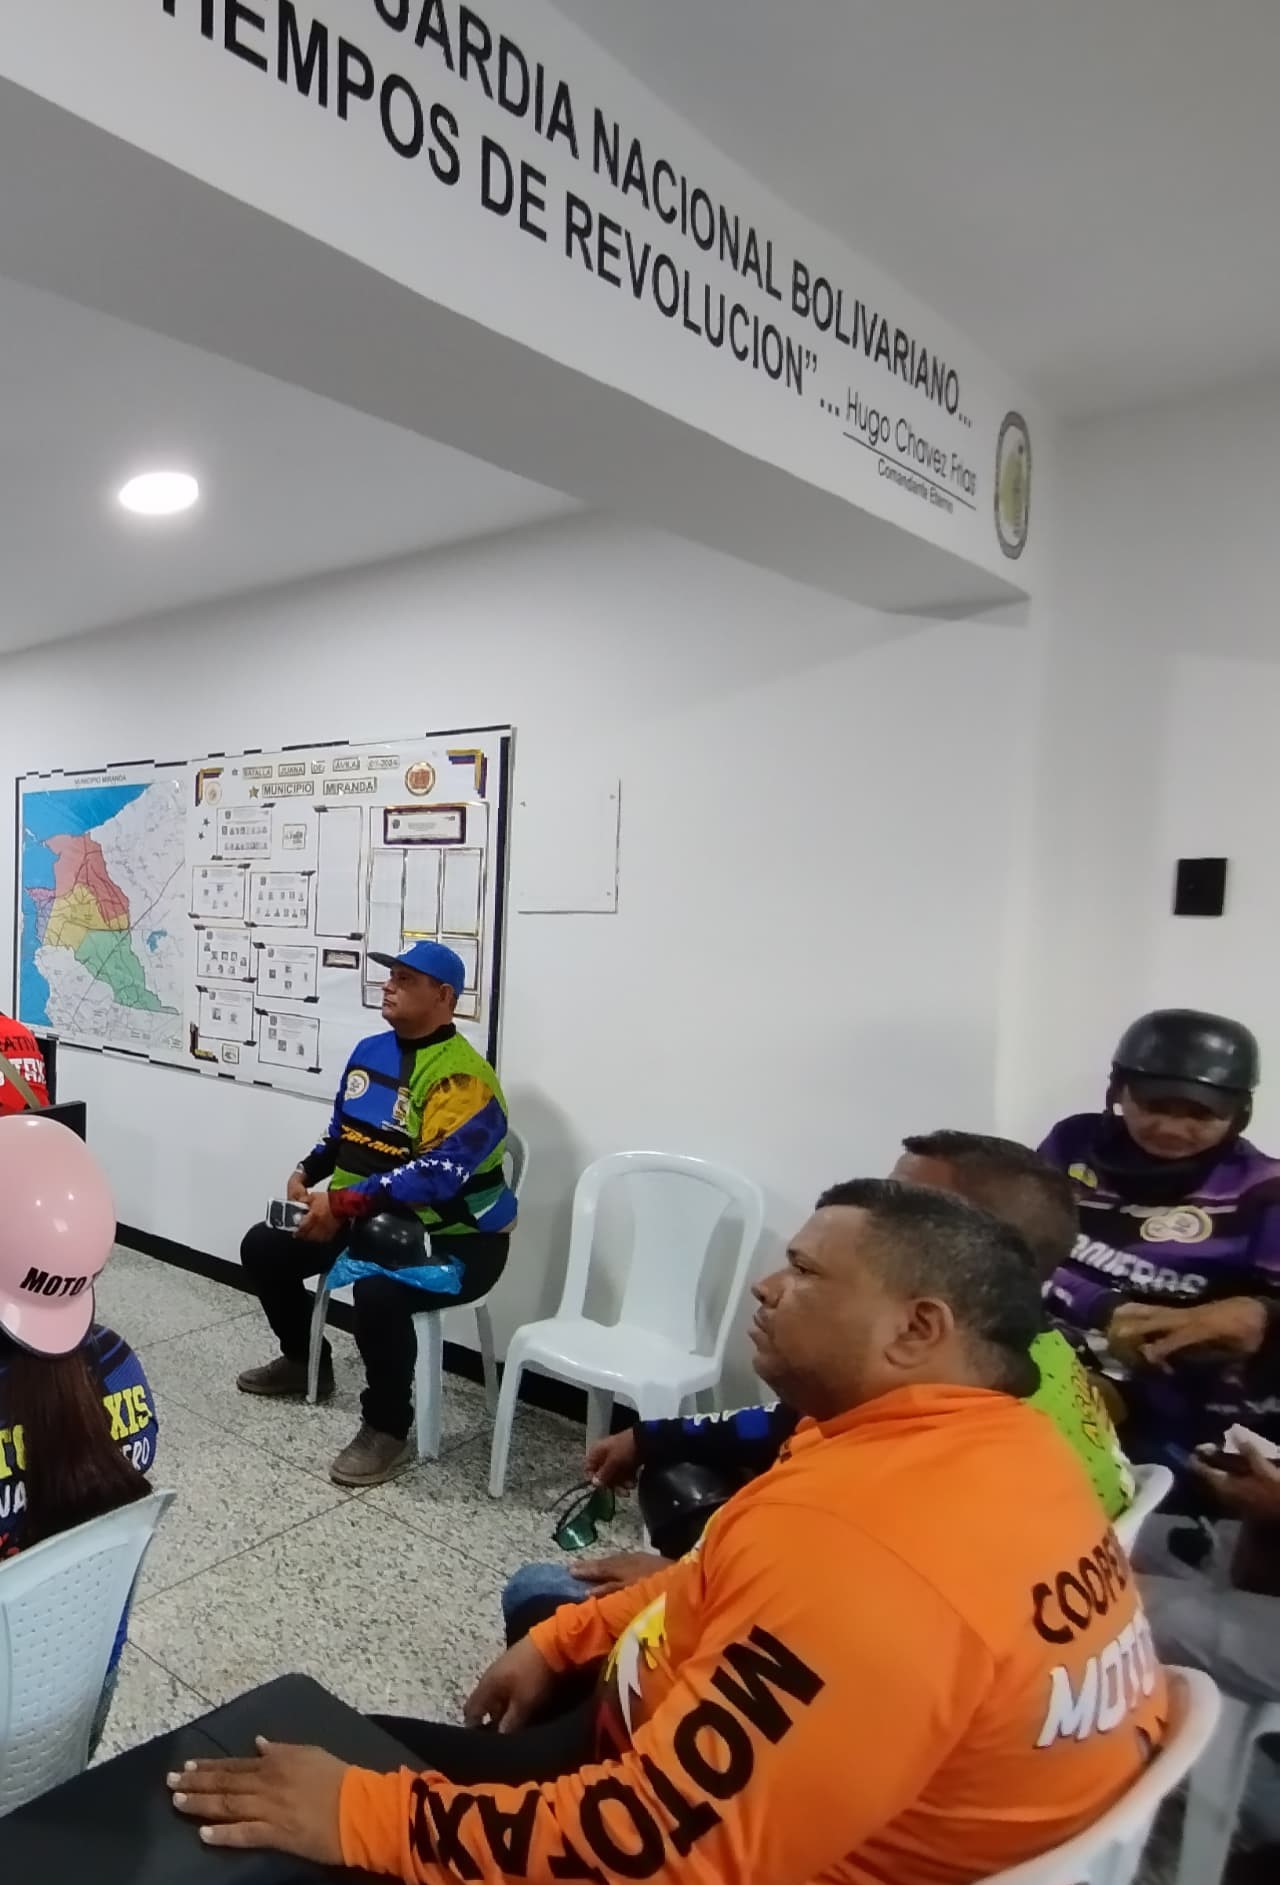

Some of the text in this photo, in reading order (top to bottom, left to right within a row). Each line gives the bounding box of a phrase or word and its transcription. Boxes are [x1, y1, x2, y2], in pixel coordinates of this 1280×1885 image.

[481, 135, 548, 243] DE
[593, 107, 782, 300] NACIONAL
[846, 386, 891, 447] Hugo
[894, 418, 947, 478] Chavez
[264, 780, 374, 797] MUNICIPIO MIRANDA
[19, 1266, 88, 1298] MOTO
